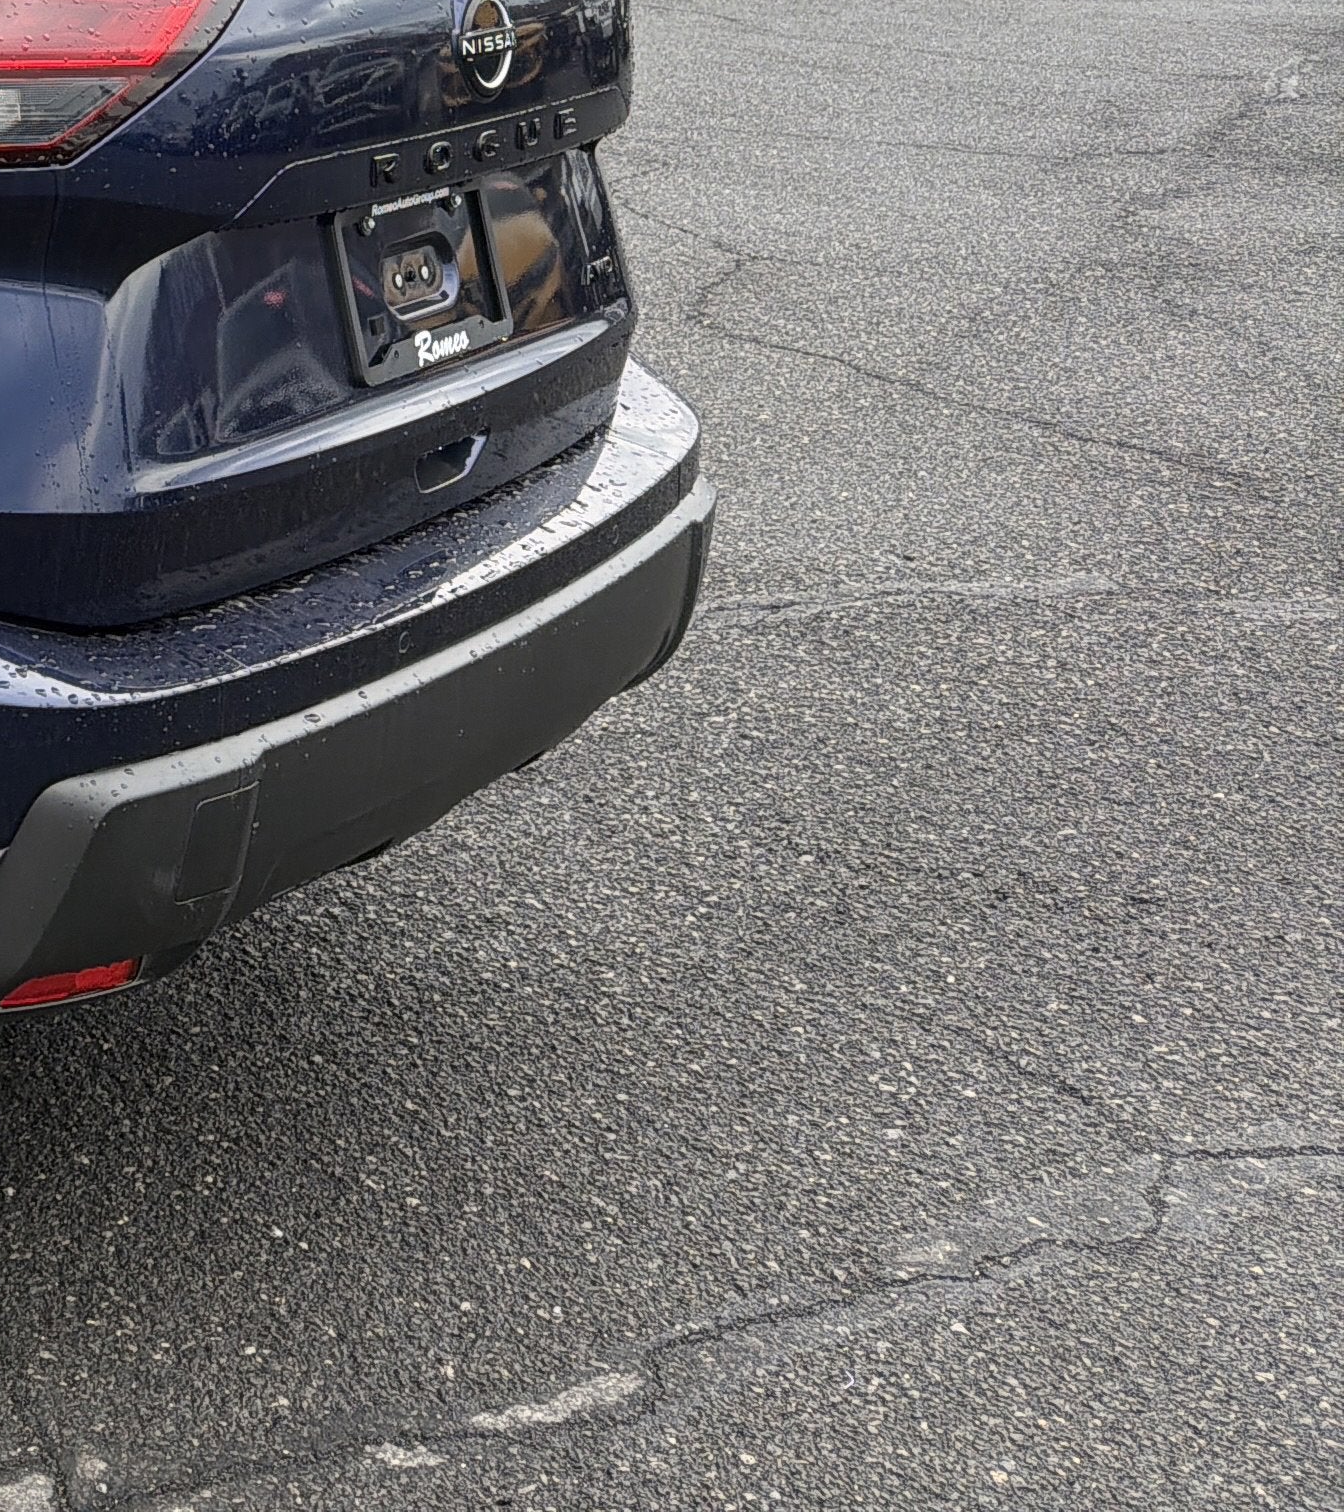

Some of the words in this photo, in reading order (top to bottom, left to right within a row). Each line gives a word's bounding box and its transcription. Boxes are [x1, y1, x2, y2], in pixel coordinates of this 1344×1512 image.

[370, 108, 577, 186] ROGUE
[371, 187, 450, 216] RomeoAutoGroup.com
[414, 329, 470, 368] Romeo
